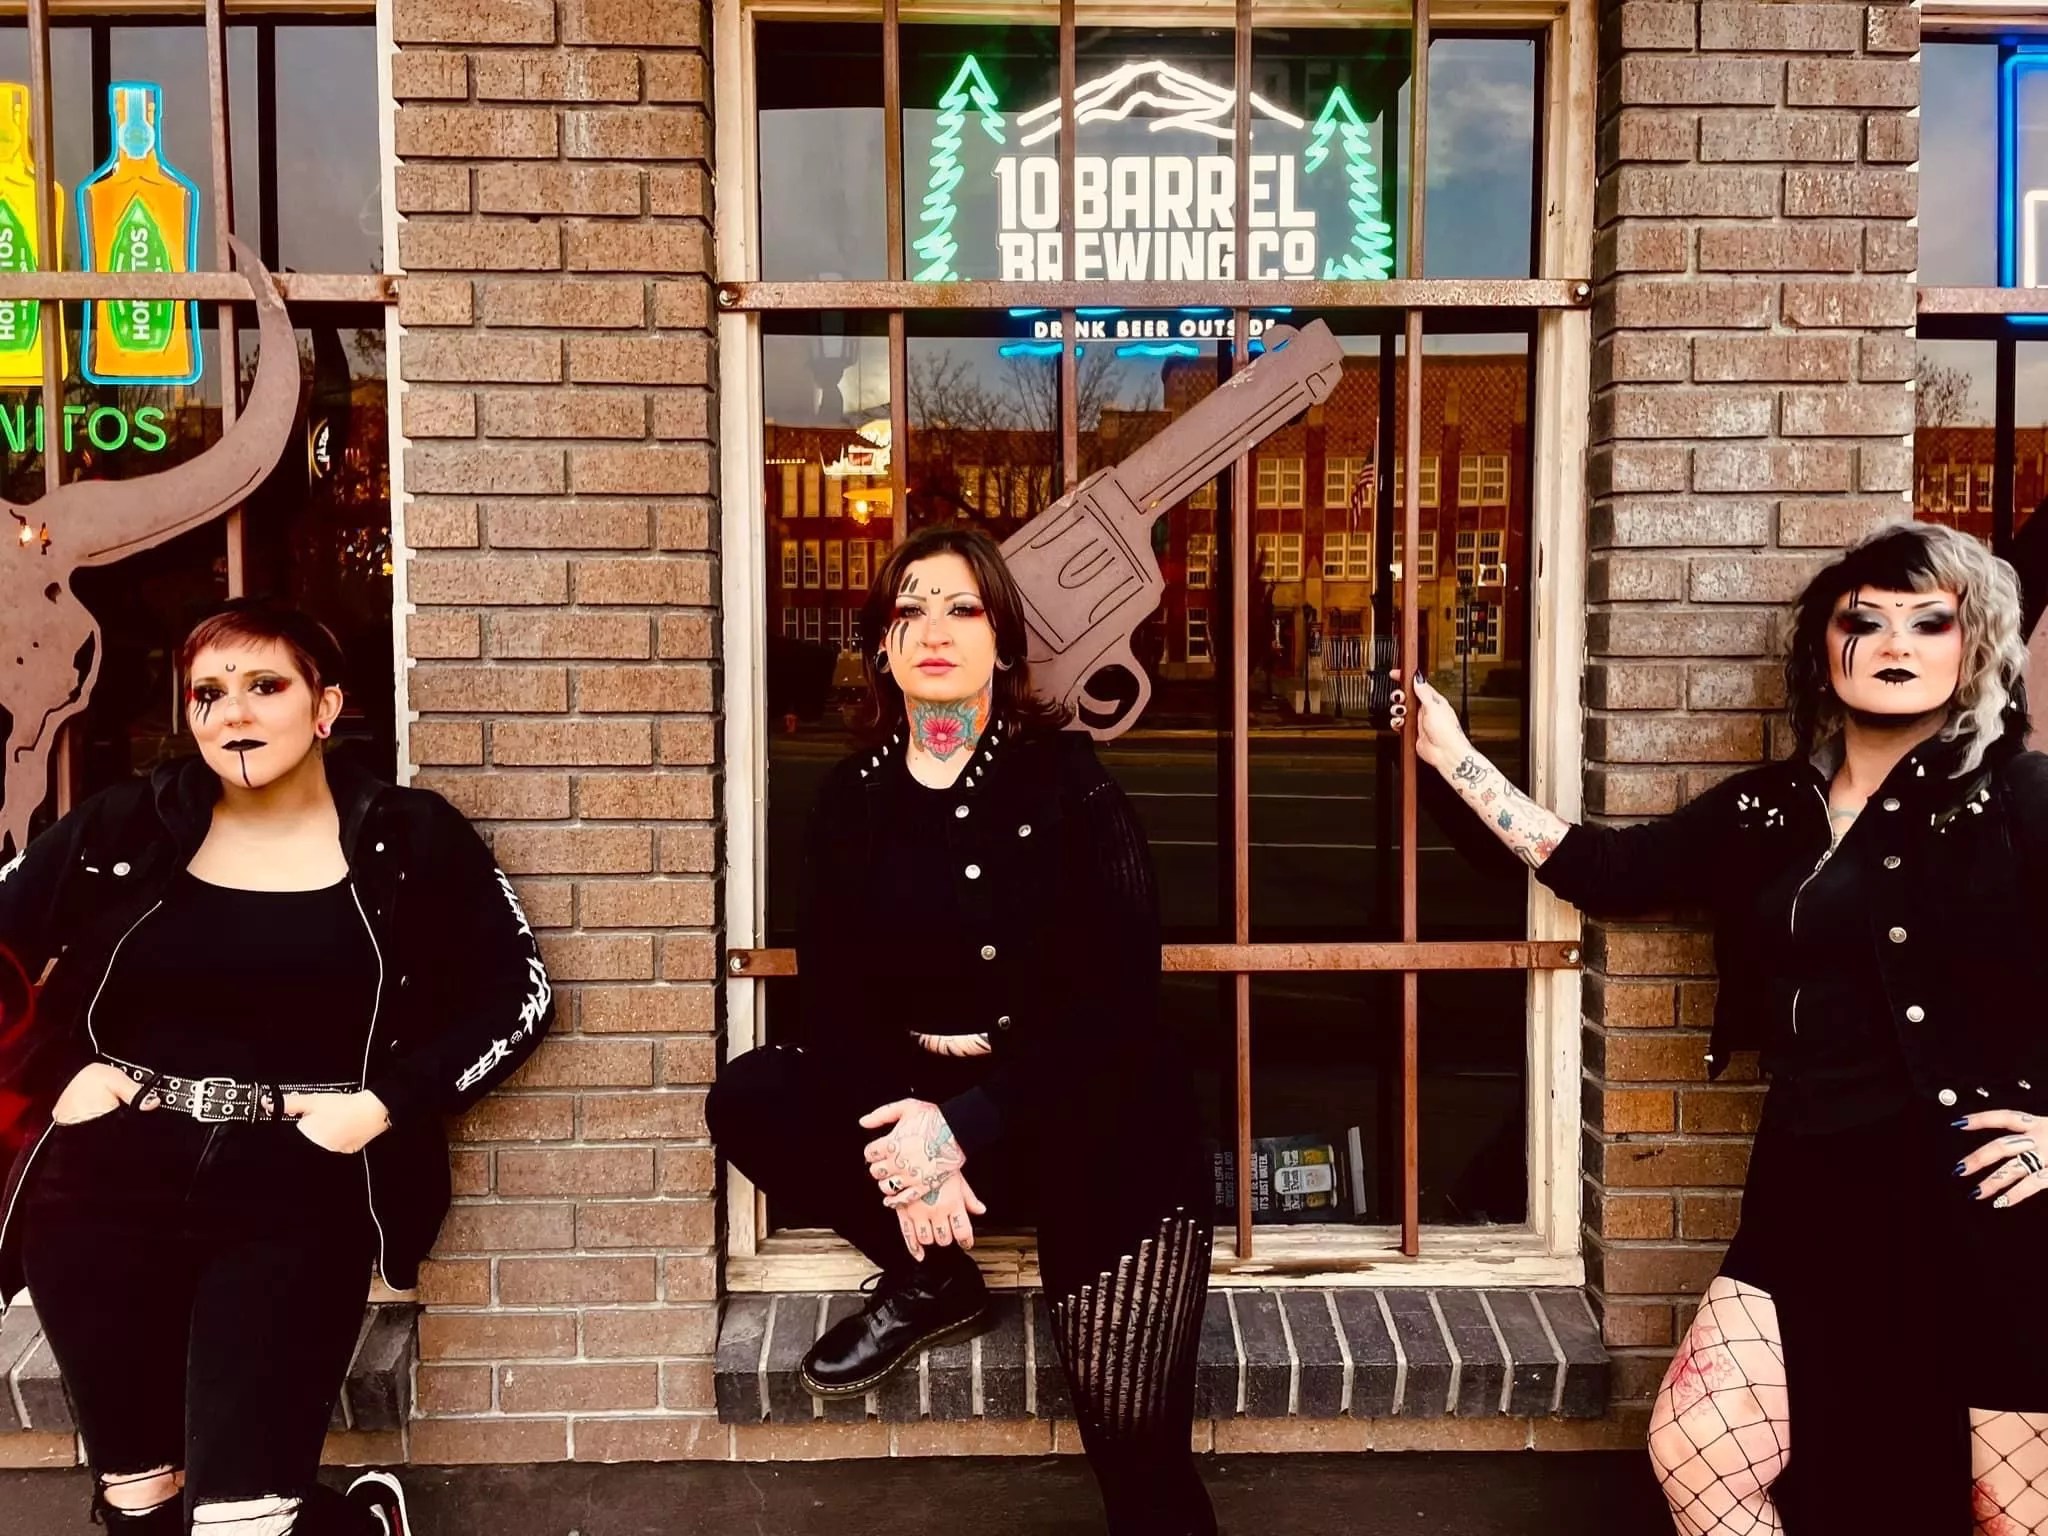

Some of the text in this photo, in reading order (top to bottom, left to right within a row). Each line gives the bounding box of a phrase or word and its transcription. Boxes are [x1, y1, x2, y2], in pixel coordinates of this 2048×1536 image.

[992, 155, 1315, 229] 10 BARREL
[130, 227, 150, 341] HOTOS
[997, 231, 1235, 280] BREWING
[1034, 319, 1275, 338] DRNK BEER OUTSD
